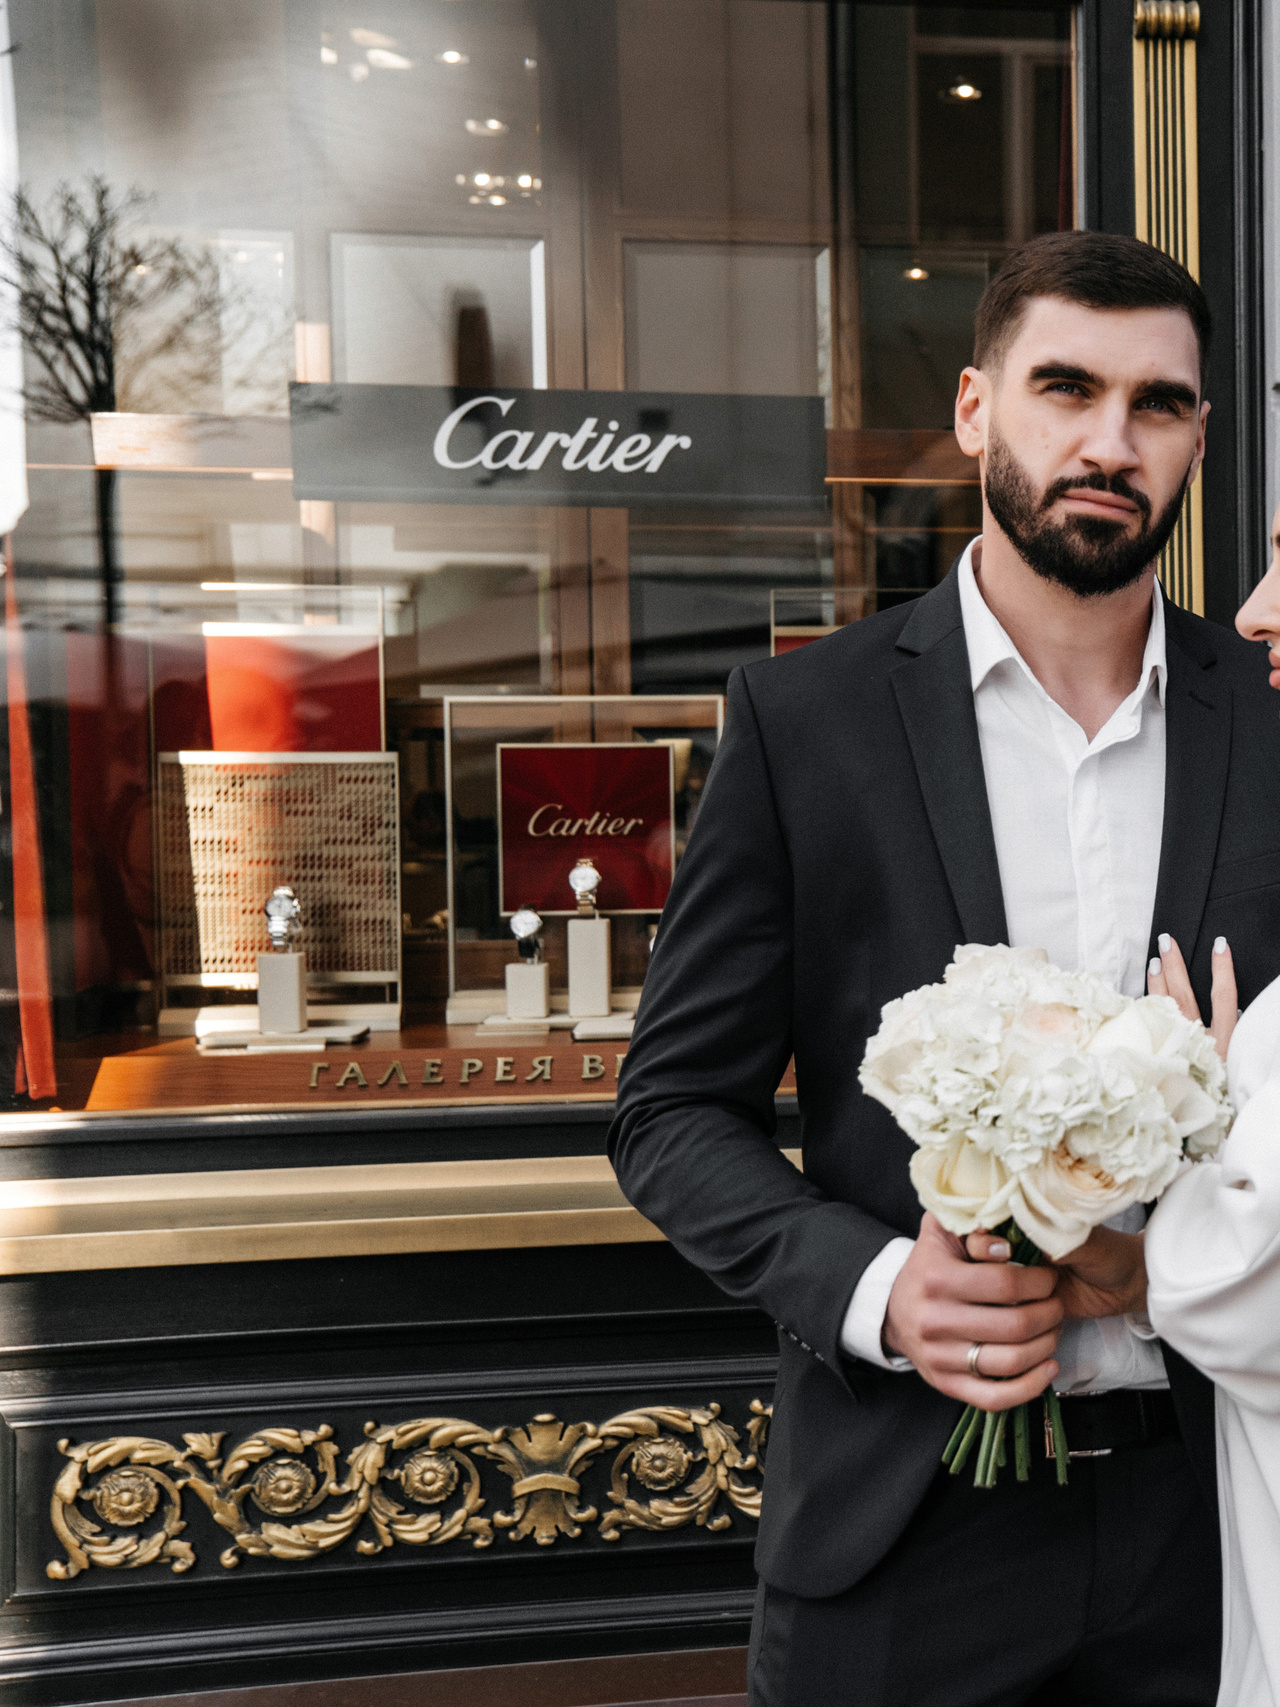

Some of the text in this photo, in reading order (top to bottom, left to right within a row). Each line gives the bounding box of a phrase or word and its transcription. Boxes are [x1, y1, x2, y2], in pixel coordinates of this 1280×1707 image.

[433, 396, 692, 473] Cartier
[527, 803, 644, 837] Cartier
[308, 1055, 554, 1088] ГАЛЕРЕЯ
